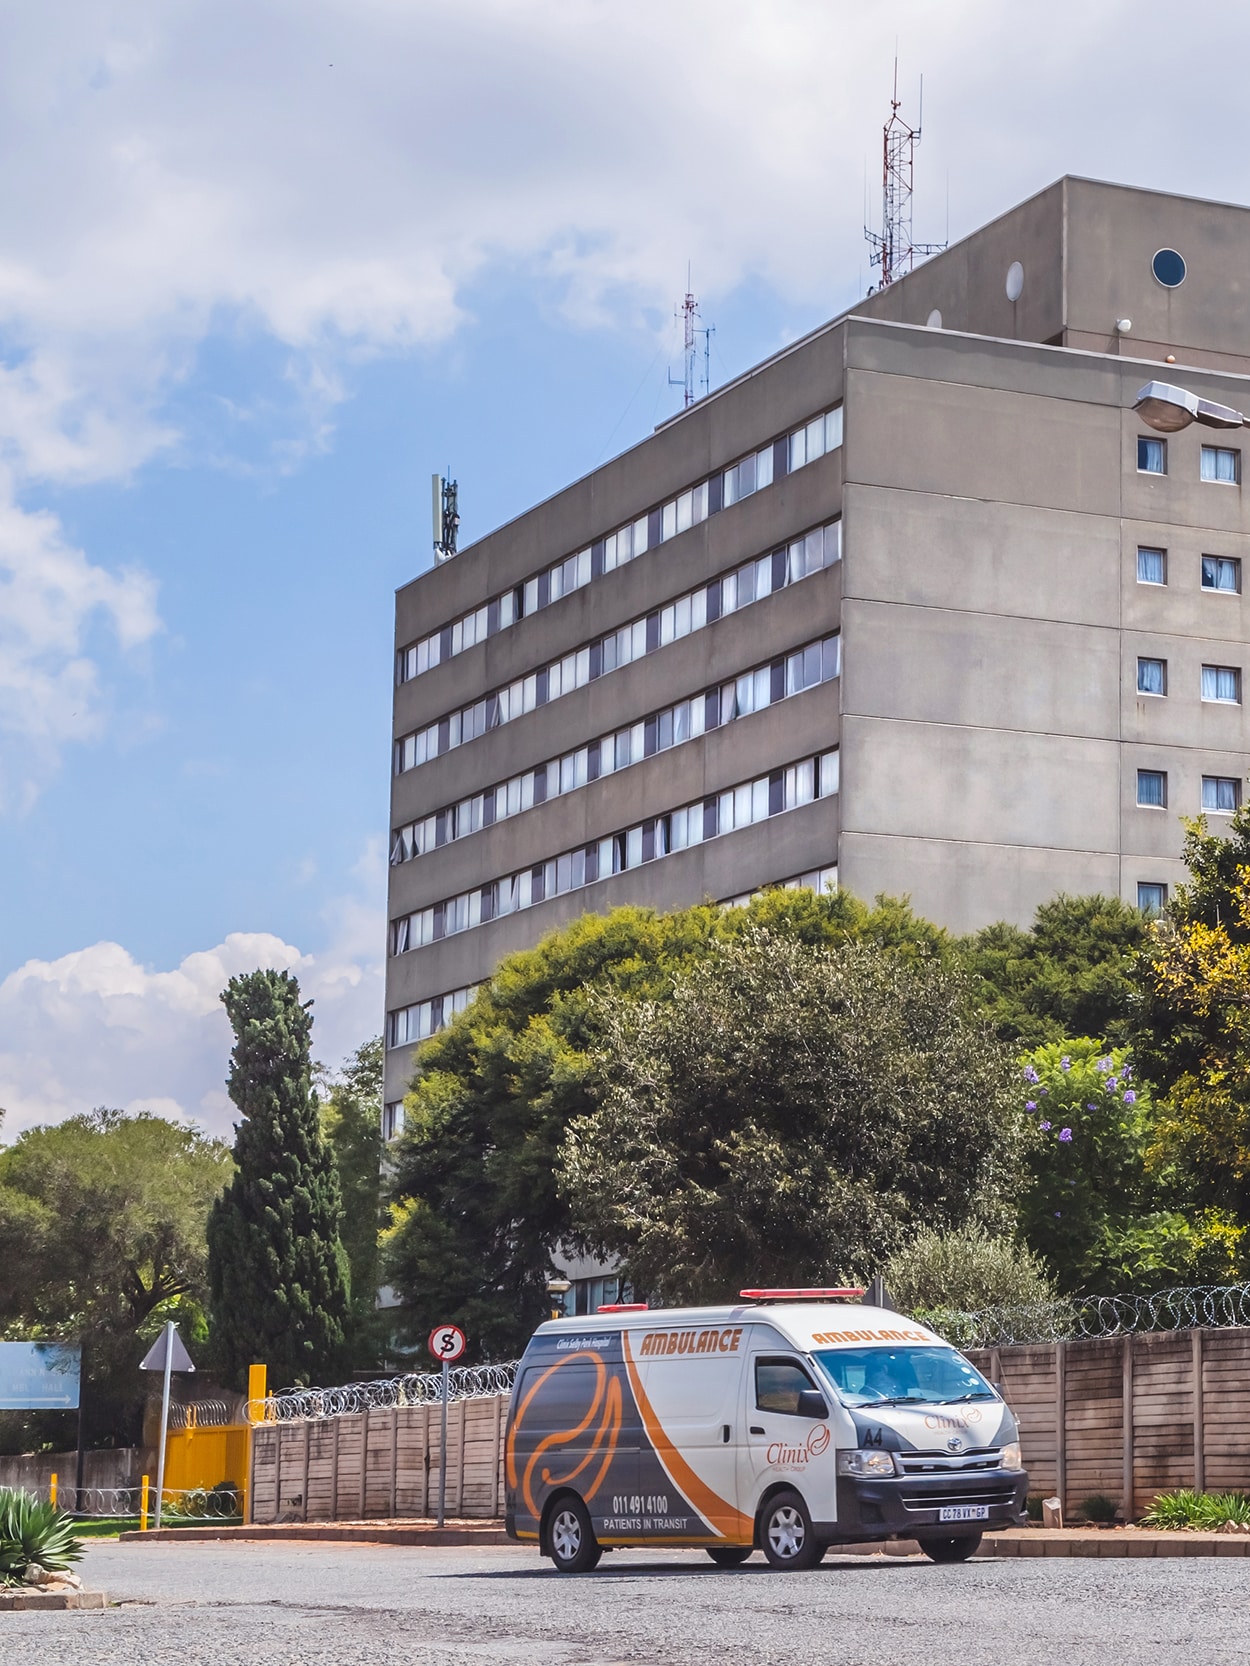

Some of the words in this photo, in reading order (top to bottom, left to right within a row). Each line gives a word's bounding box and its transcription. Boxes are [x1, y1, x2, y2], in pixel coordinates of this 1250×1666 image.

[440, 1334, 455, 1352] S
[640, 1328, 744, 1355] AMBULANCE
[811, 1330, 931, 1344] AMBULANCE
[924, 1414, 969, 1430] Clinix
[863, 1428, 883, 1447] A4
[766, 1442, 810, 1464] Clinix
[613, 1495, 628, 1514] 011
[629, 1495, 645, 1514] 491
[646, 1495, 668, 1514] 4100
[603, 1519, 641, 1530] PATIENTS
[643, 1519, 652, 1529] IN
[652, 1518, 688, 1529] TRANSIT
